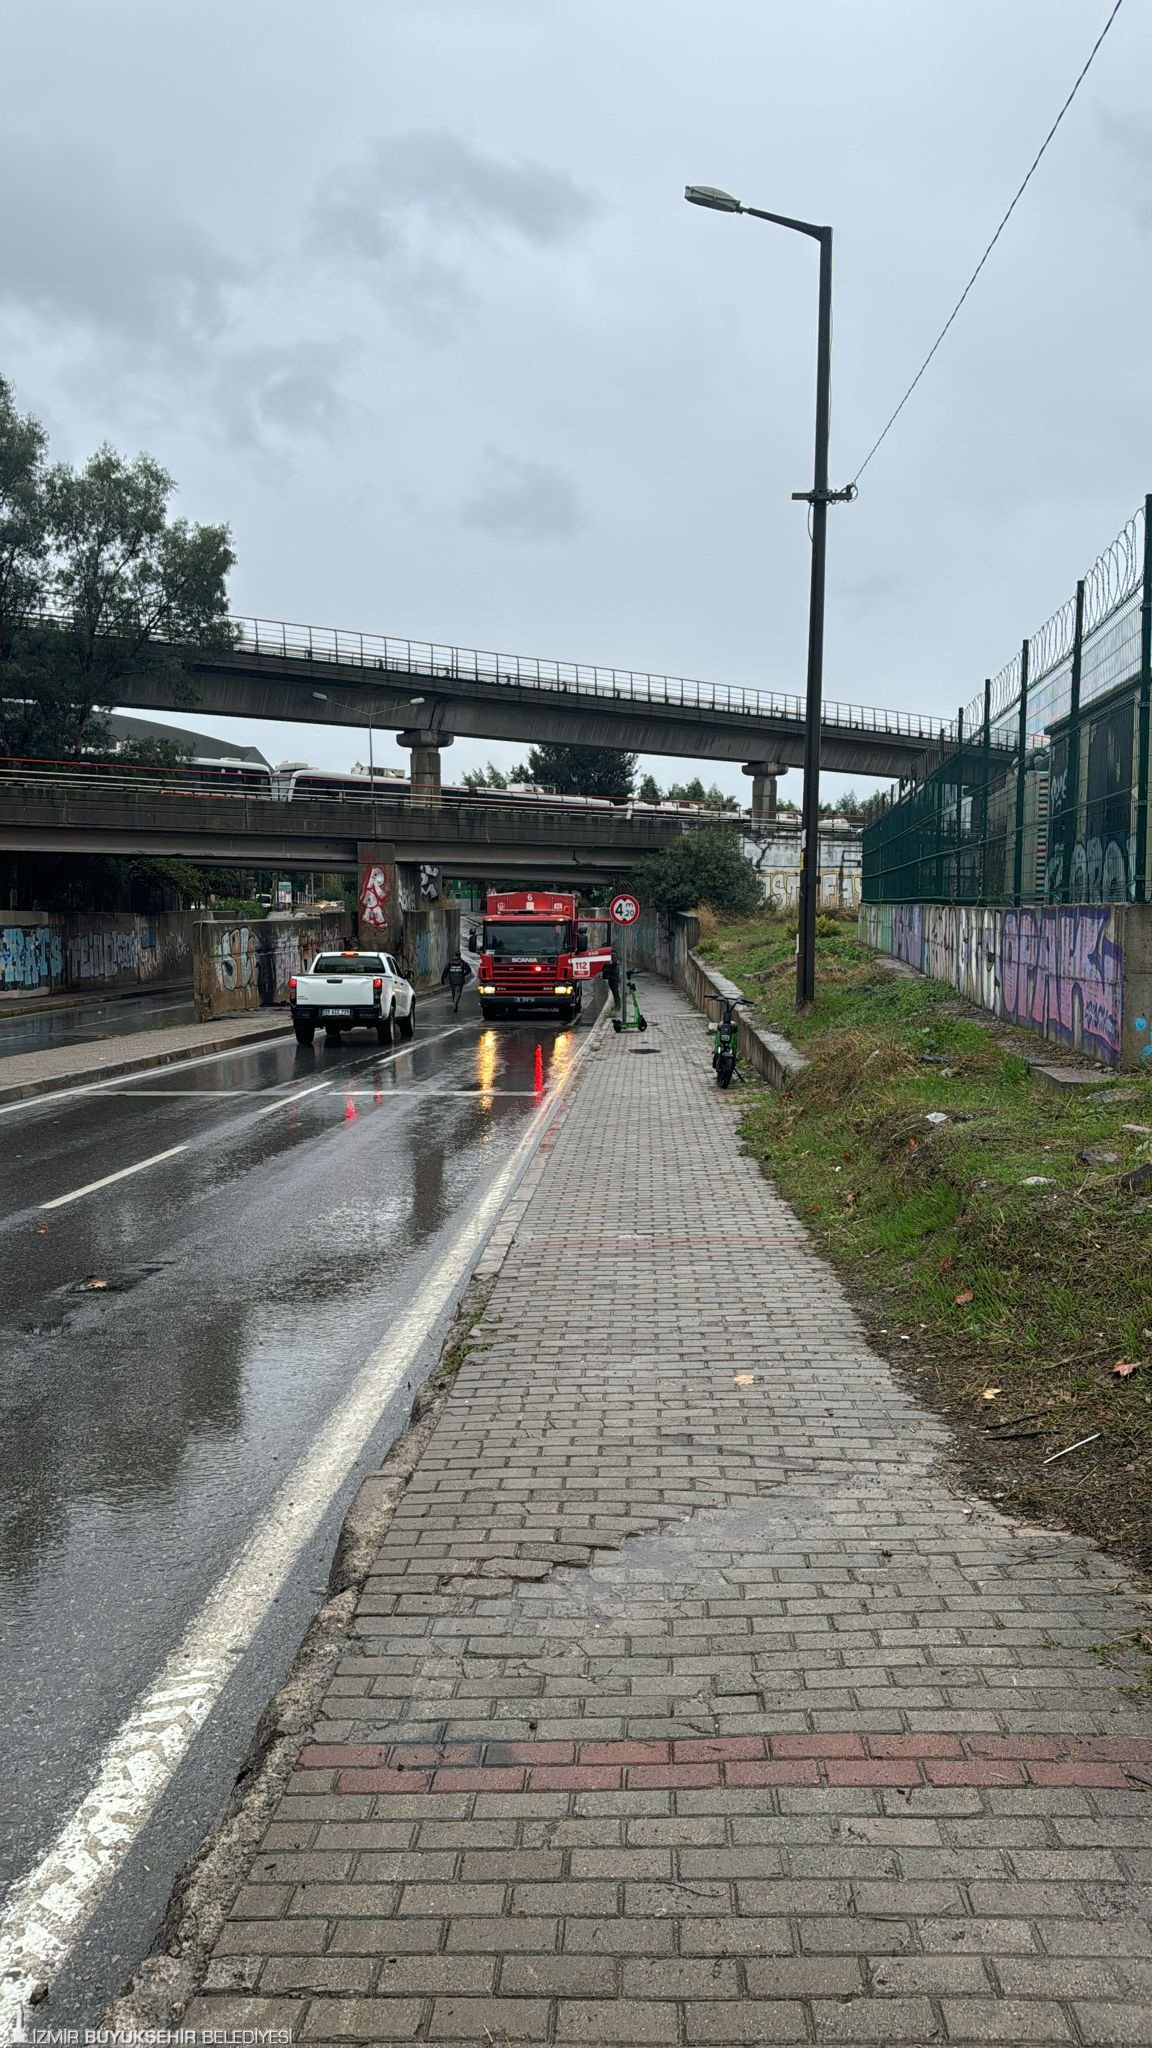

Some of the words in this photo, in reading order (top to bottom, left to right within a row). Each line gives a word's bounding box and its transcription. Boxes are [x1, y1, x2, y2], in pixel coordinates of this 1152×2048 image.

[527, 893, 533, 901] 6
[615, 903, 624, 917] 4
[575, 961, 588, 970] 112
